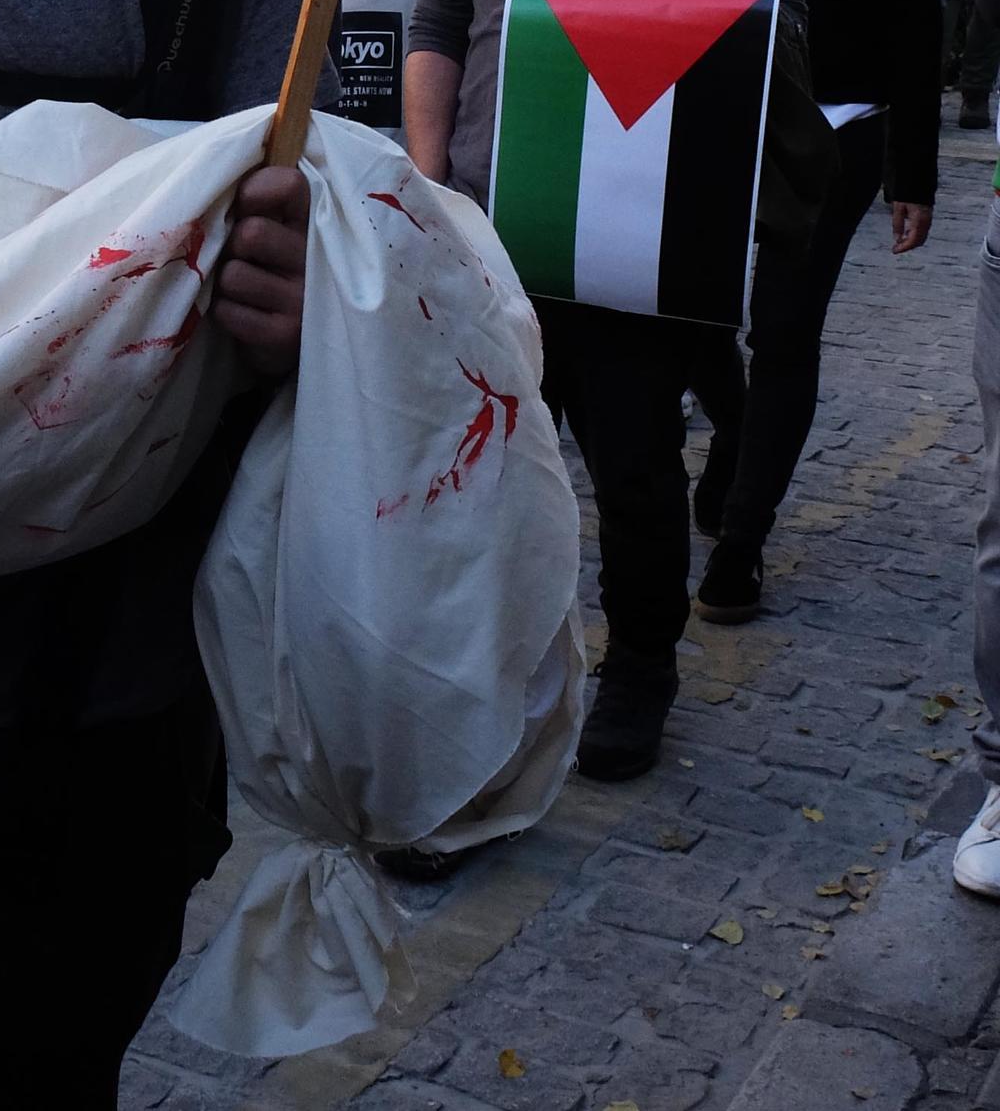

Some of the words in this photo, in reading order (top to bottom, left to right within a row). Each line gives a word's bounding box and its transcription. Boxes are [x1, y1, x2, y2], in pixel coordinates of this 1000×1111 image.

[341, 36, 385, 64] kyo
[353, 87, 377, 95] STARTS
[378, 87, 393, 95] NOW
